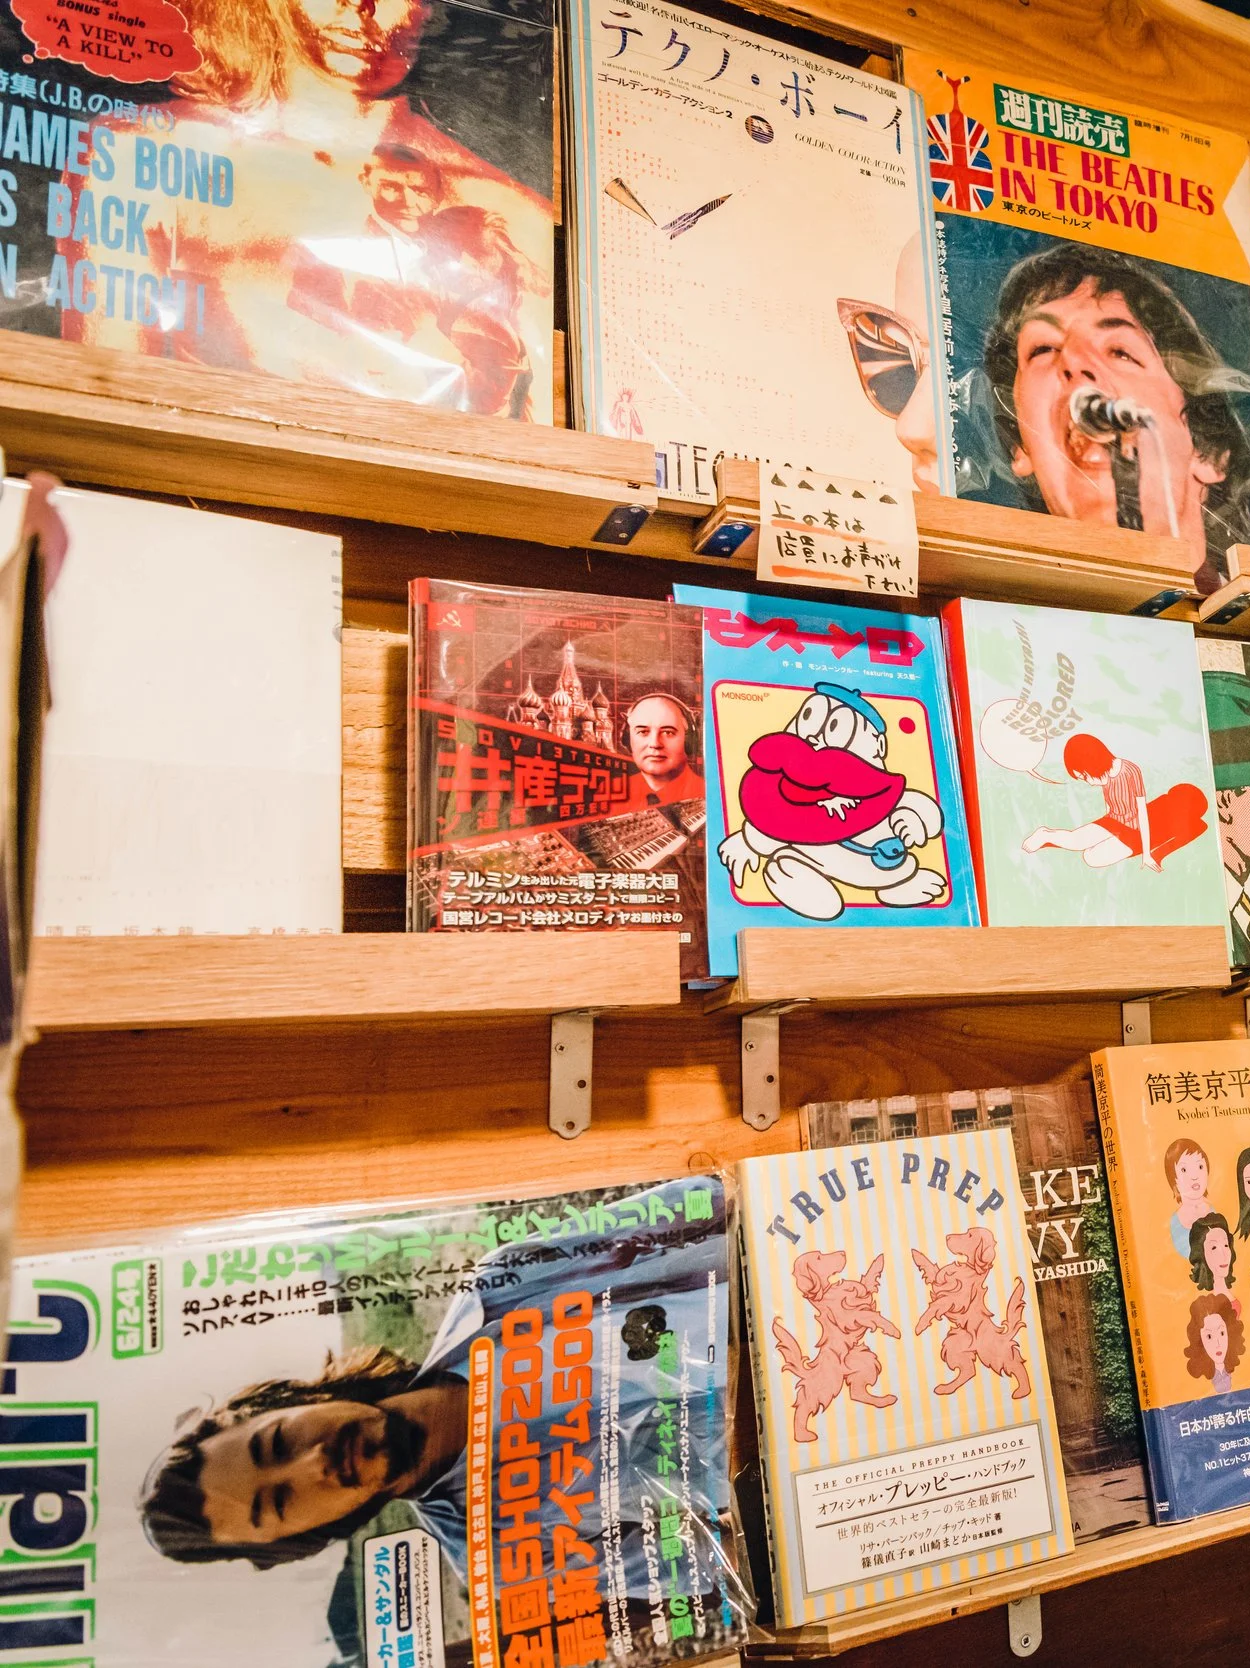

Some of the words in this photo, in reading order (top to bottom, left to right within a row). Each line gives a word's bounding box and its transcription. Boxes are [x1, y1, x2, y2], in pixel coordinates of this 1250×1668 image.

[57, 0, 100, 16] BONUS
[108, 11, 146, 28] single
[80, 23, 136, 47] VIEW
[145, 39, 174, 58] TO
[57, 36, 70, 49] A
[601, 10, 903, 155] テクノ・ボーイ
[795, 133, 833, 152] GOLDEN
[999, 88, 1126, 155] 週刊読売
[0, 103, 116, 182] AMES
[135, 137, 234, 208] BOND
[997, 129, 1066, 176] THE
[1081, 151, 1215, 216] BEATLES
[47, 181, 150, 256] BACK
[1000, 168, 1036, 205] IN
[1048, 178, 1158, 233] TOKYO
[1001, 200, 1092, 231] 東京のビートルズ
[771, 500, 865, 533] 上の本は
[721, 691, 764, 702] MONSOON
[863, 669, 893, 679] featuring
[1020, 651, 1076, 735] COLORED
[1008, 701, 1043, 730] RED
[1029, 707, 1083, 742] ELEGY
[437, 743, 628, 813] 共産テクノ
[1094, 1064, 1118, 1172] 筒美京平の世界
[1177, 1106, 1211, 1122] Kyohei
[767, 1157, 875, 1246] TRUE
[901, 1152, 1006, 1217] PREP
[1033, 1259, 1109, 1282] YASHIDA
[500, 1307, 552, 1668] 全国SHOP200
[549, 1291, 607, 1662] 最新アイテム500
[815, 1480, 838, 1491] THE
[845, 1465, 905, 1485] OFFICIAL
[912, 1453, 955, 1470] PREPPY
[962, 1438, 1025, 1458] HANDBOOK
[818, 1458, 1026, 1516] オフィシャル・プレッピー・ハンドブック
[837, 1487, 1018, 1541] 世界的ベストセラーの完全最新版!
